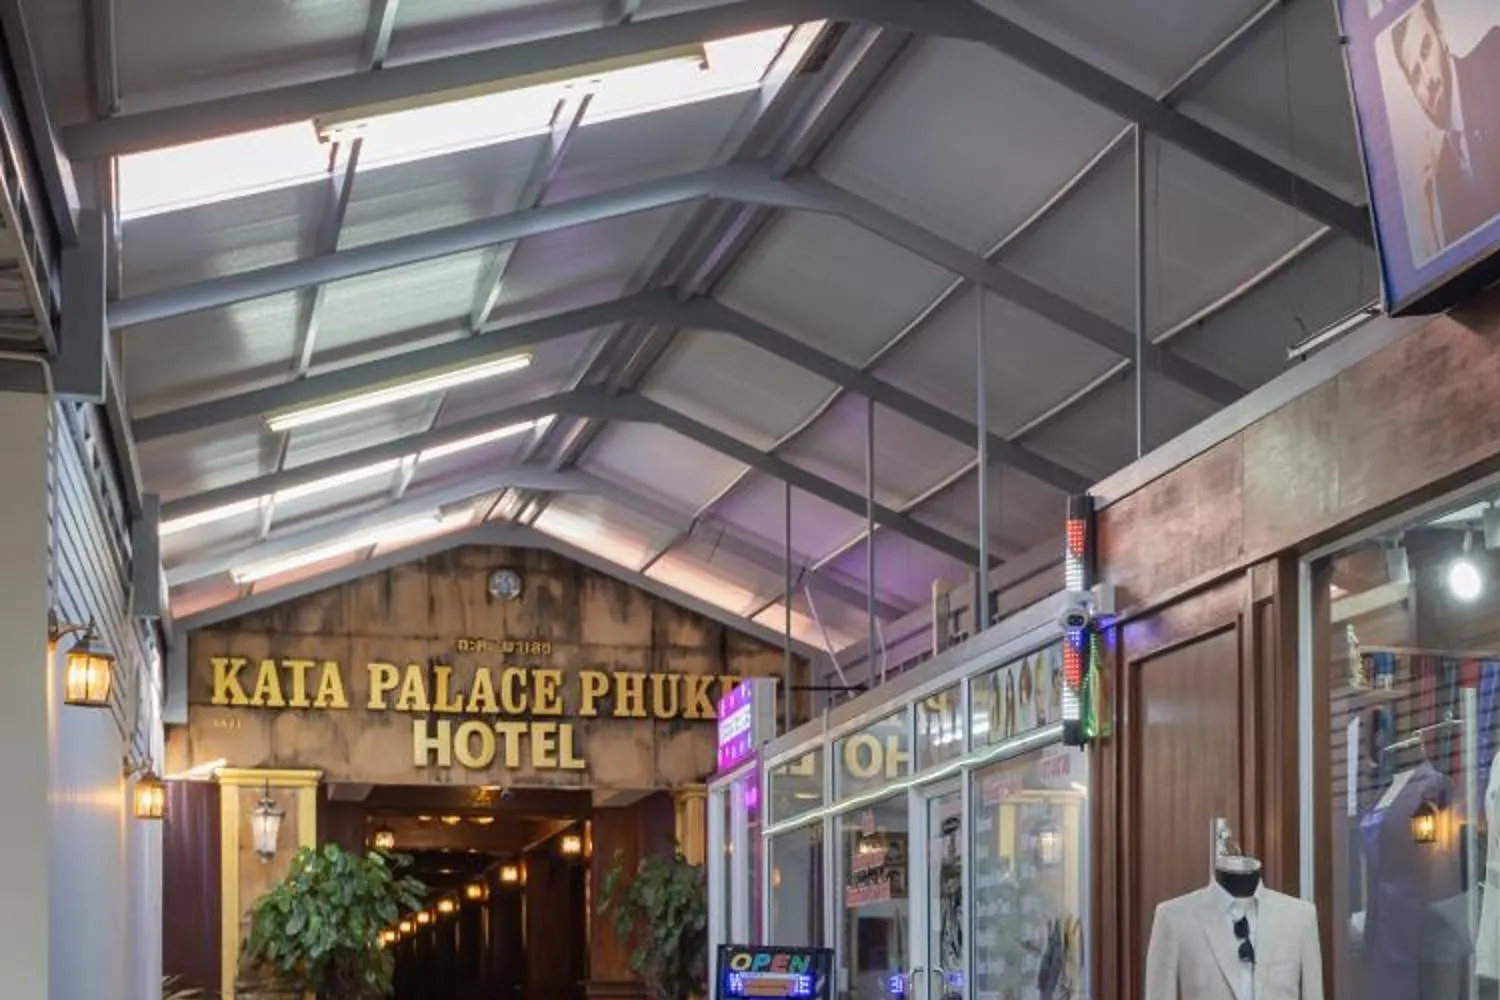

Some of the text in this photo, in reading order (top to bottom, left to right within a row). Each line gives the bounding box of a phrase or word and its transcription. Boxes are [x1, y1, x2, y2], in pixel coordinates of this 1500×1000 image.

[209, 657, 349, 710] KATA
[367, 662, 563, 717] PALACE
[412, 718, 587, 771] HOTEL
[730, 952, 811, 973] OPEN
